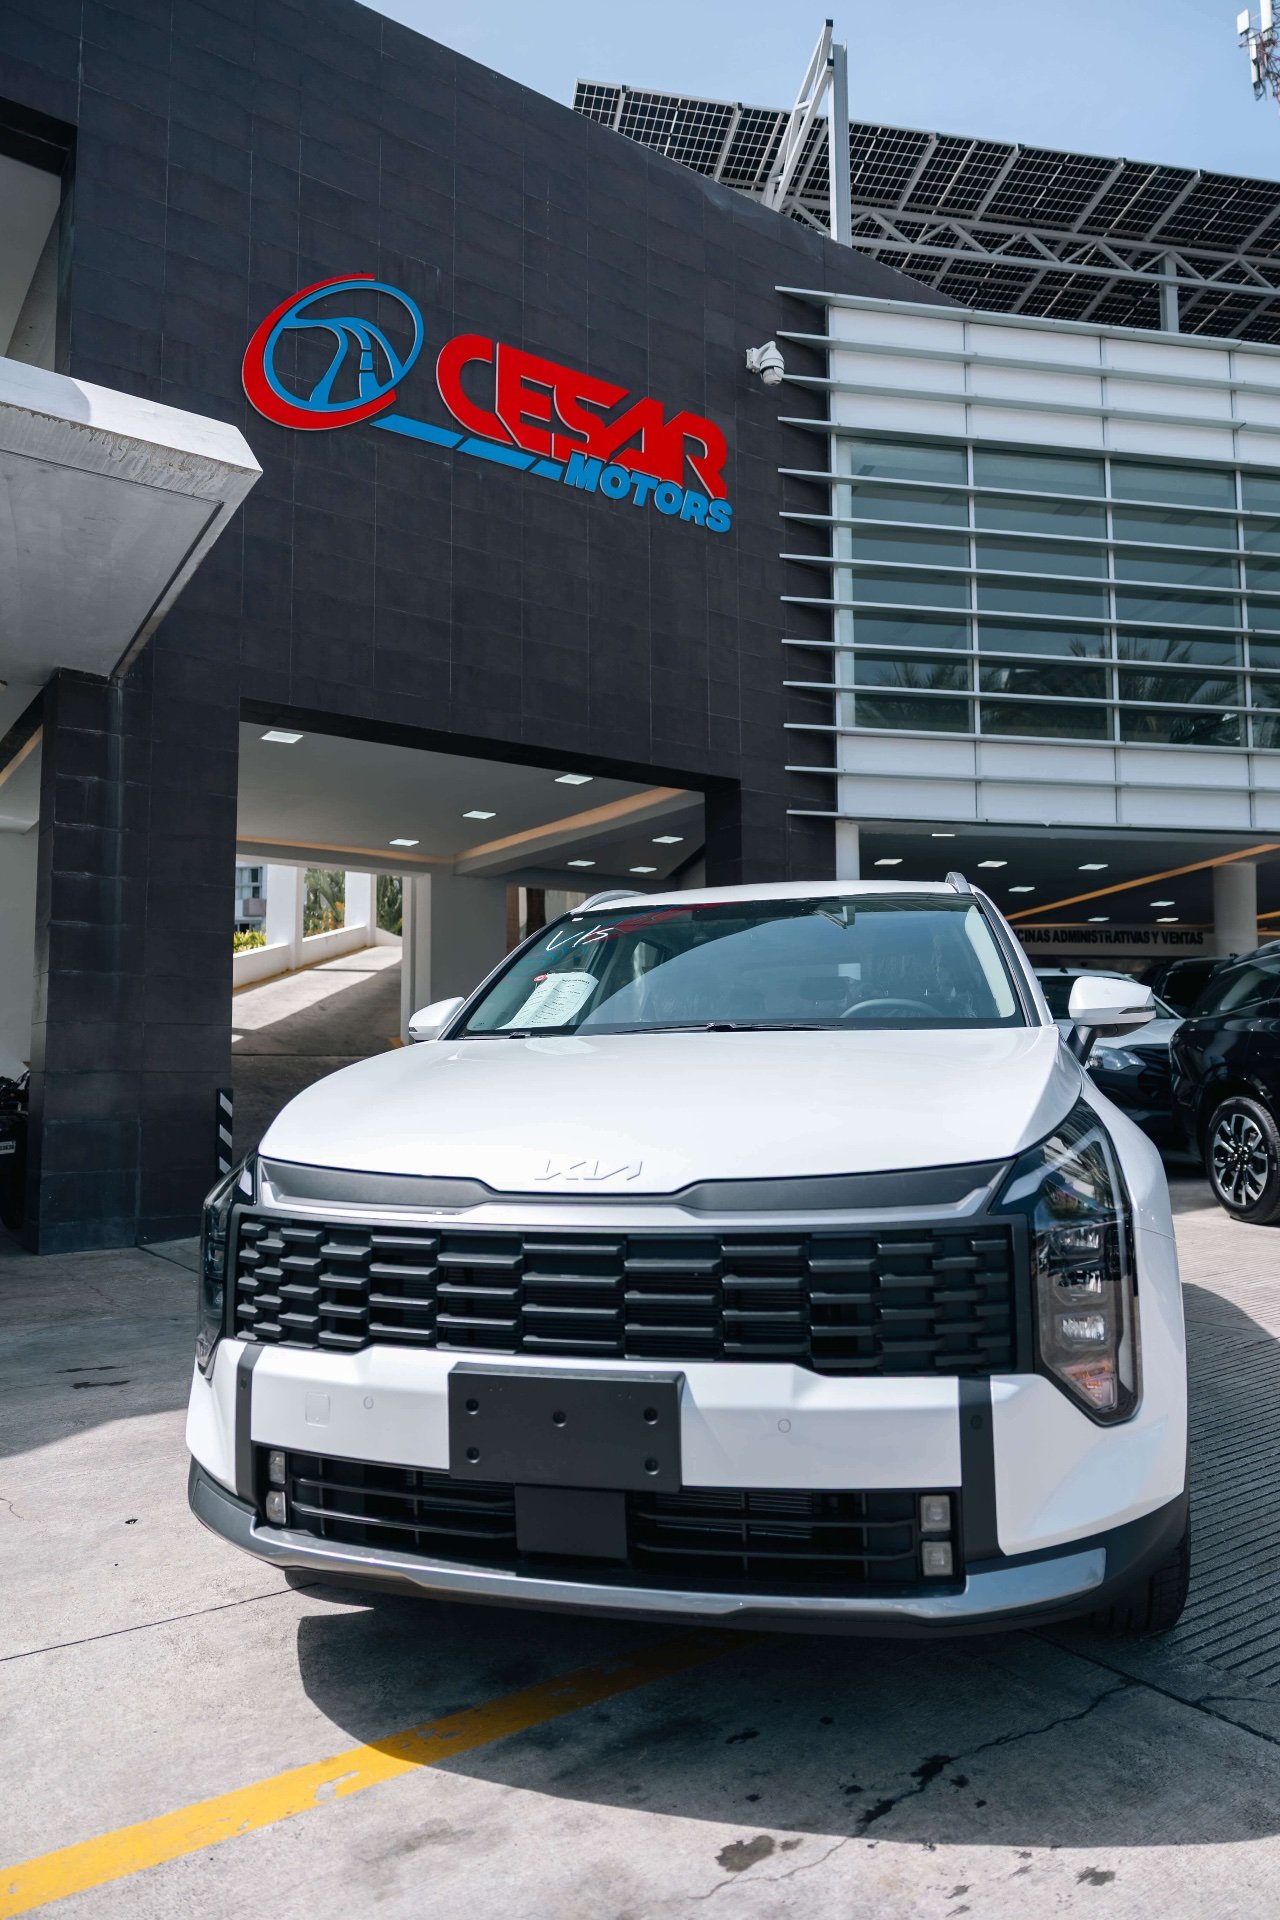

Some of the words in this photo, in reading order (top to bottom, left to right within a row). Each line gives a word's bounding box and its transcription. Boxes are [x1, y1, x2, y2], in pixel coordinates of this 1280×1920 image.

[436, 334, 728, 499] CESAR
[564, 452, 732, 533] MOTORS
[1151, 930, 1160, 944] Y
[1161, 931, 1204, 944] VENTAS
[534, 1159, 643, 1181] KIA
